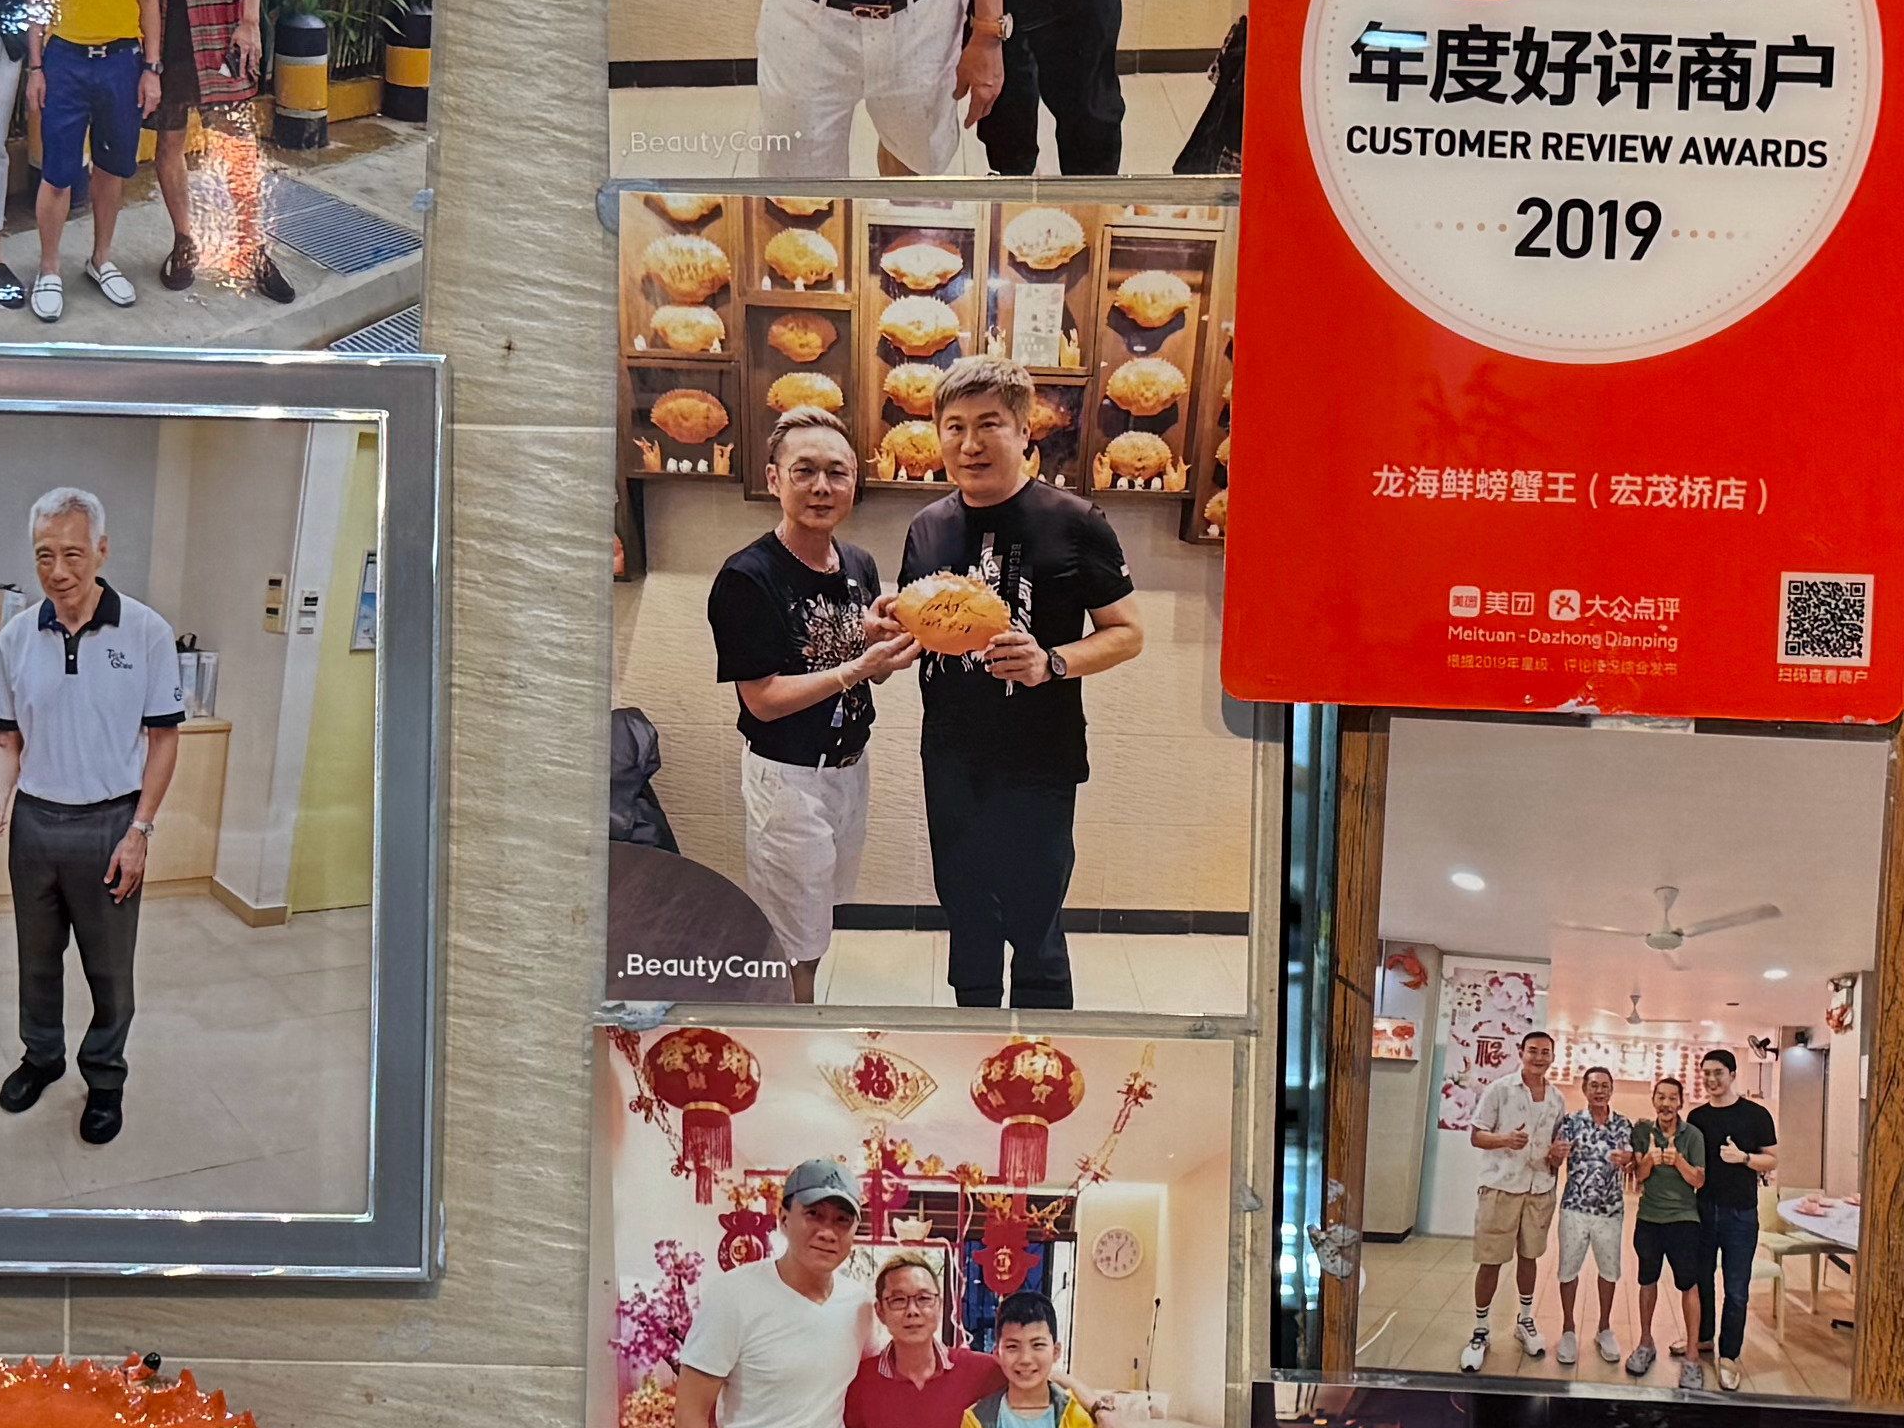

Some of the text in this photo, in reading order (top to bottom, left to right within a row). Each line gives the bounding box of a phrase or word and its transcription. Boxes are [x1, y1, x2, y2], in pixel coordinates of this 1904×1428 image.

[1346, 20, 1837, 114] 年度好评商户
[629, 131, 793, 158] BeautyCam
[1346, 124, 1829, 172] CUSTOMER REVIEW AWARDS
[1513, 196, 1664, 262] 2019
[1484, 590, 1536, 616] 美团
[1584, 594, 1681, 622] 大众点评
[1447, 625, 1516, 643] Meituan
[1528, 628, 1602, 650] Dazhong
[1605, 631, 1679, 653] Dianping
[625, 954, 789, 985] BeautyCam
